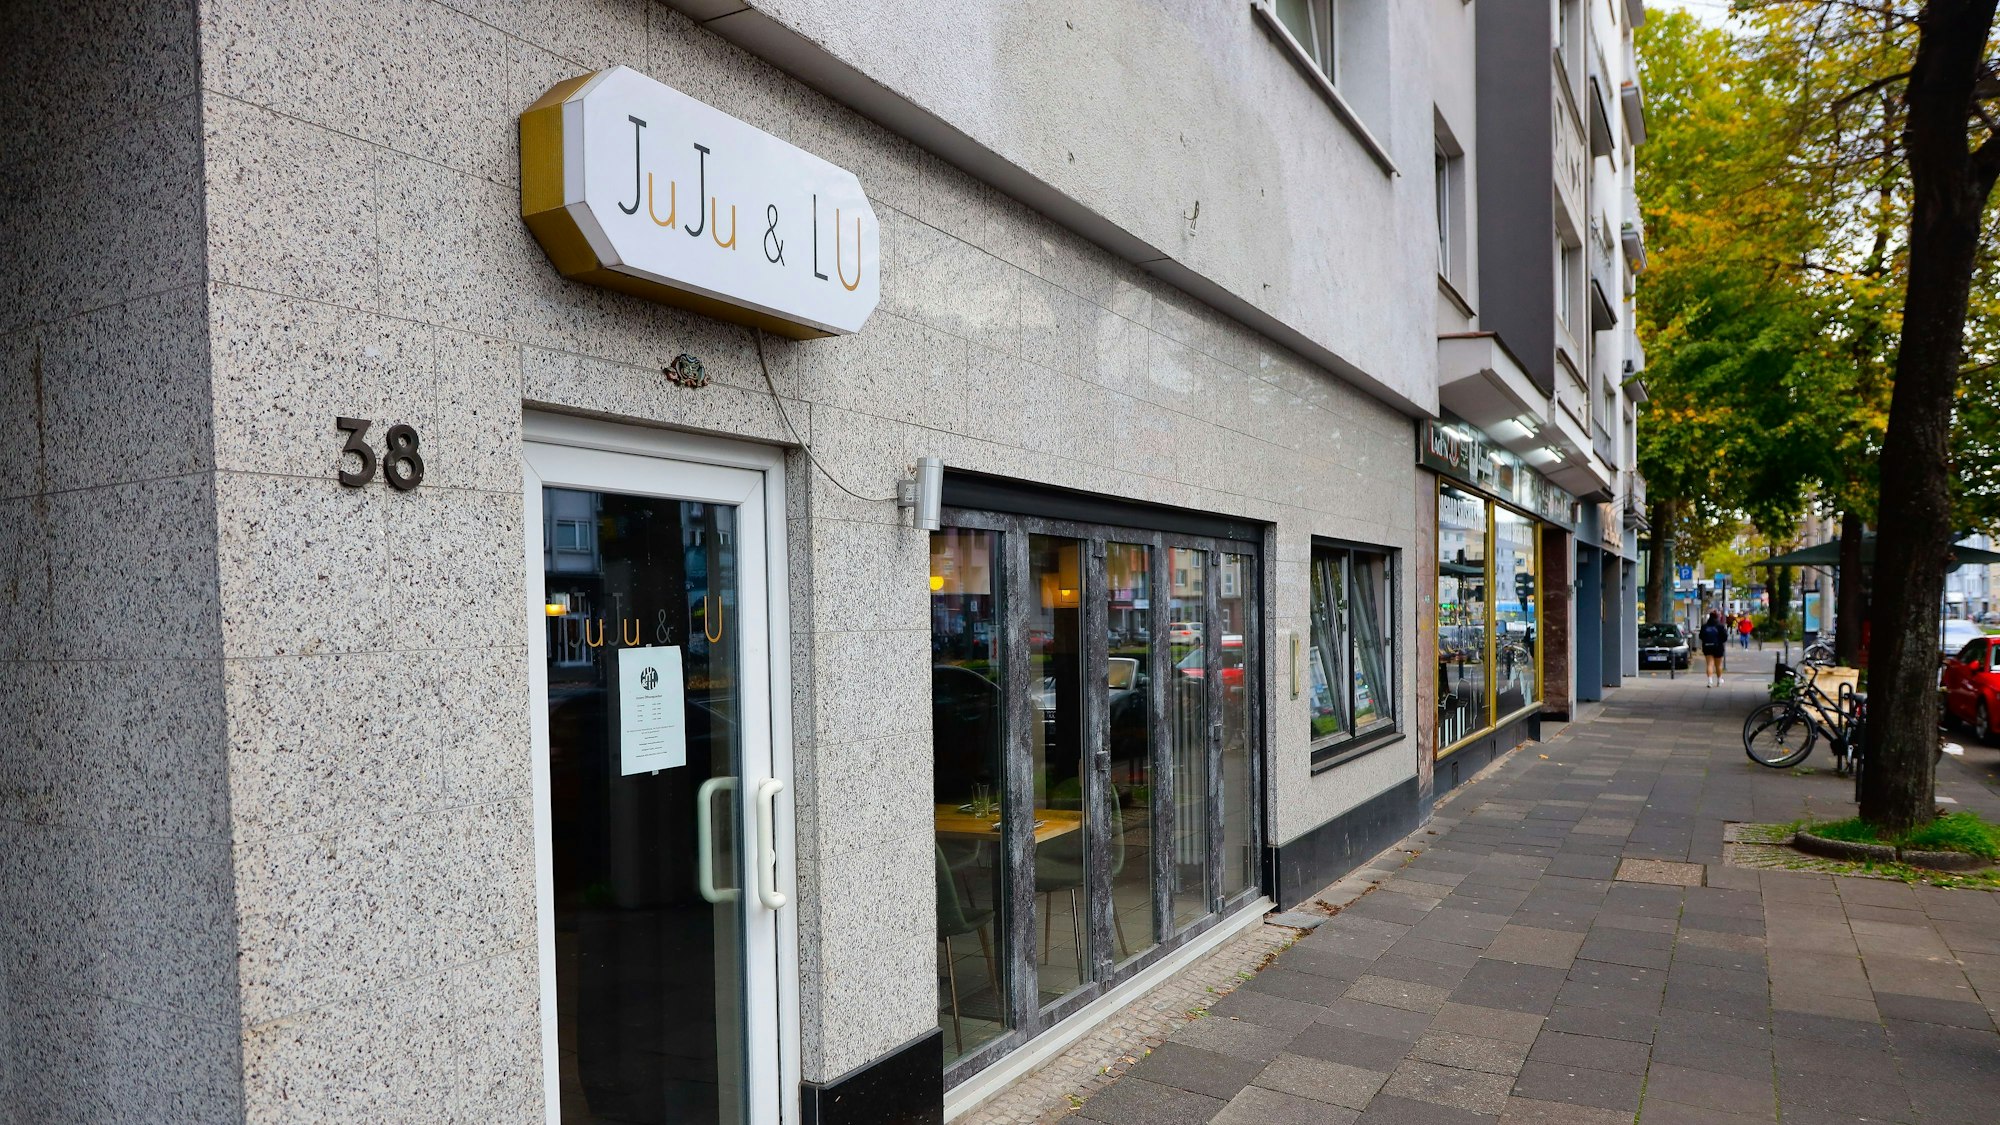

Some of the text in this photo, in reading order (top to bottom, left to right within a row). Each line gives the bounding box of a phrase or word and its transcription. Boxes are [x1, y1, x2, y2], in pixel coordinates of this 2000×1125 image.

[618, 114, 861, 291] JuJu & LU
[336, 416, 425, 490] 38
[569, 592, 640, 647] JuJu
[656, 608, 674, 643] &
